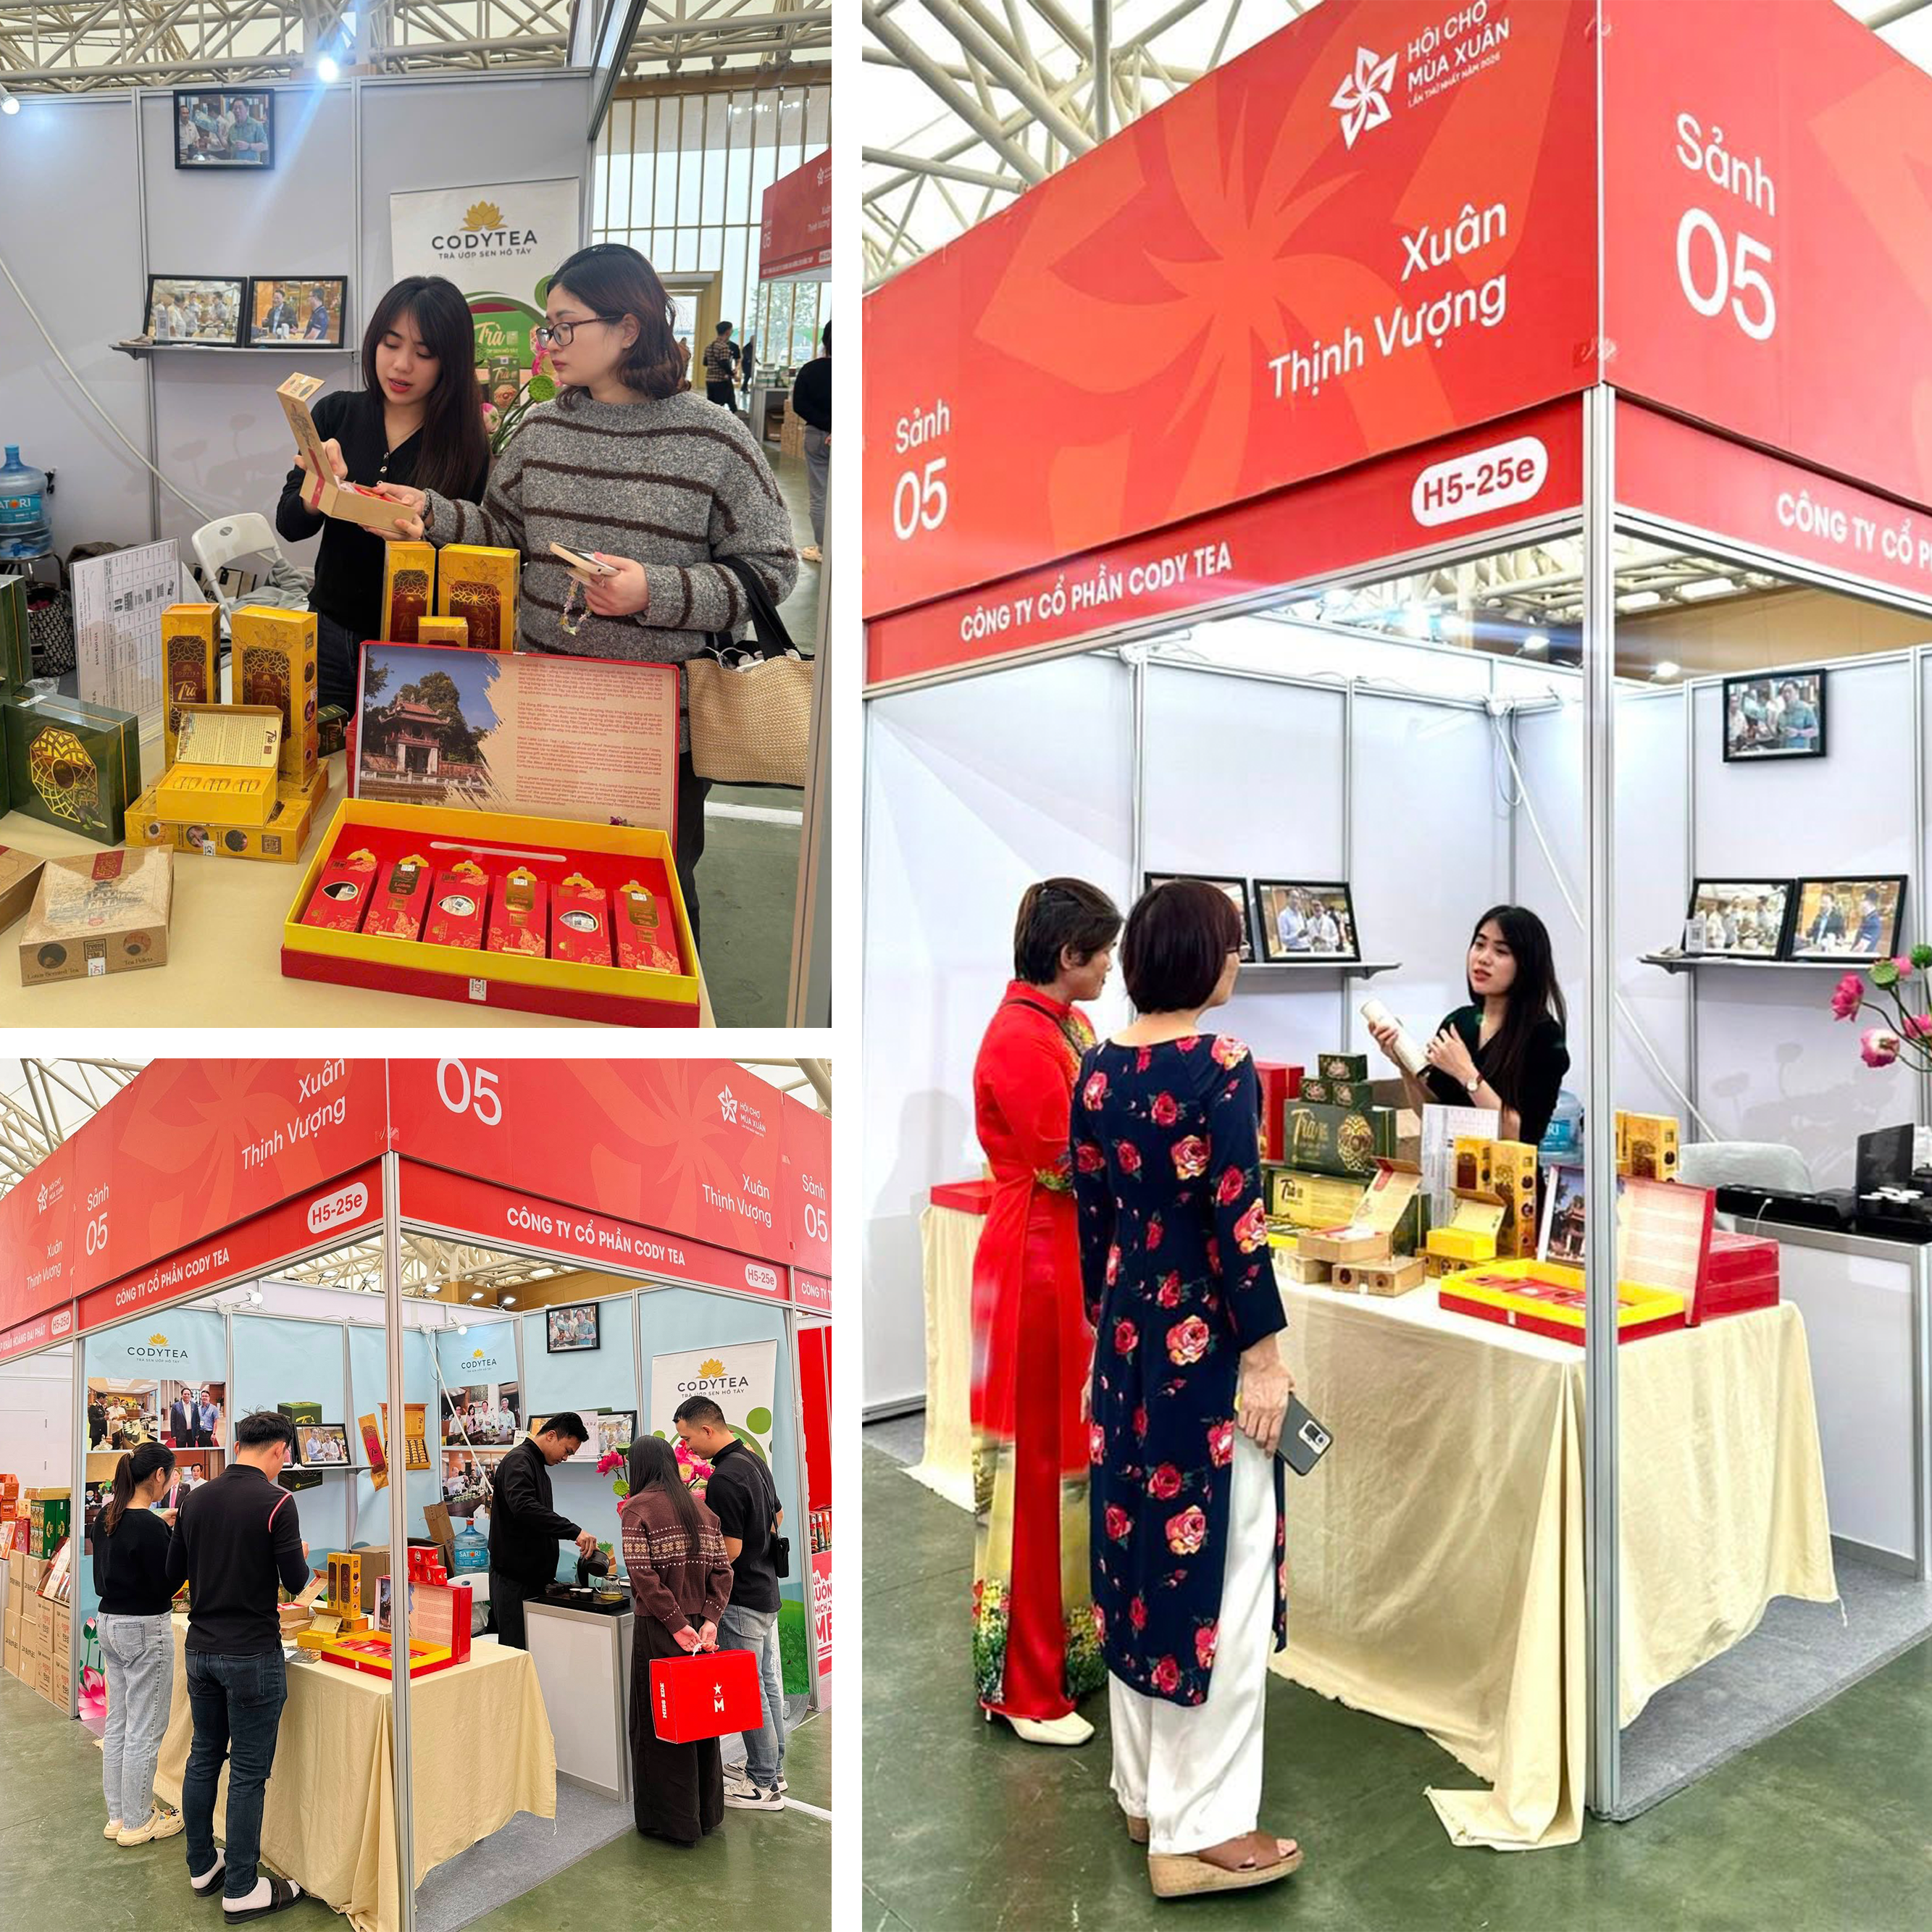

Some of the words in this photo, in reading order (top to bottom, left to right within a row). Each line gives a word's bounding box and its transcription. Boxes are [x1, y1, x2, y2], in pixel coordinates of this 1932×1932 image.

[1408, 25, 1439, 63] HỘI
[1444, 0, 1488, 40] CHỢ
[1408, 54, 1450, 93] MÙA
[1454, 17, 1510, 67] XUÂN
[1676, 112, 1776, 217] Sảnh
[432, 230, 538, 250] CODYTEA
[1401, 202, 1507, 283] Xuân
[1676, 207, 1777, 342] 05
[1268, 332, 1364, 401] Thịnh
[1373, 274, 1507, 358] Vượng
[895, 398, 950, 453] Sảnh
[893, 457, 949, 541] 05
[1422, 455, 1536, 513] H5-25e
[1776, 492, 1847, 545] CÔNG
[1852, 518, 1876, 552] TY
[1882, 516, 1912, 561] CỔ
[961, 598, 1011, 643] CÔNG
[1013, 595, 1034, 628] TY
[1037, 571, 1068, 618] CỔ
[1071, 562, 1124, 613] PHẦN
[1129, 551, 1188, 596] CODY
[1194, 540, 1233, 576] TEA
[298, 1059, 346, 1103] Xuân
[436, 1058, 503, 1126] 05
[242, 1129, 283, 1170] Thịnh
[287, 1095, 346, 1144] Vượng
[87, 1182, 110, 1213] Sảnh
[312, 1191, 363, 1226] H5-25e
[702, 1183, 735, 1213] Thịnh
[737, 1196, 772, 1229] Vượng
[743, 1173, 770, 1200] Xuân
[802, 1174, 826, 1201] Sảnh
[85, 1211, 109, 1257] 05
[507, 1206, 553, 1236] CÔNG
[556, 1220, 571, 1239] TY
[574, 1219, 595, 1247] CỔ
[599, 1226, 632, 1254] PHẦN
[634, 1239, 666, 1262] CODY
[667, 1247, 686, 1266] TEA
[804, 1203, 829, 1242] 05
[46, 1239, 63, 1260] Xuân
[26, 1271, 42, 1291] Thịnh
[115, 1284, 137, 1308] CÔNG
[137, 1284, 146, 1300] TY
[147, 1268, 159, 1293] CỔ
[161, 1260, 184, 1289] PHẦN
[185, 1255, 212, 1280] CODY
[212, 1247, 230, 1268] TEA
[748, 1268, 775, 1286] H5-25e
[801, 1281, 820, 1297] CÔNG
[127, 1346, 188, 1359] CODYTEA
[461, 1358, 498, 1369] CODYTEA
[677, 1376, 749, 1392] CODYTEA
[714, 1698, 724, 1713] M
